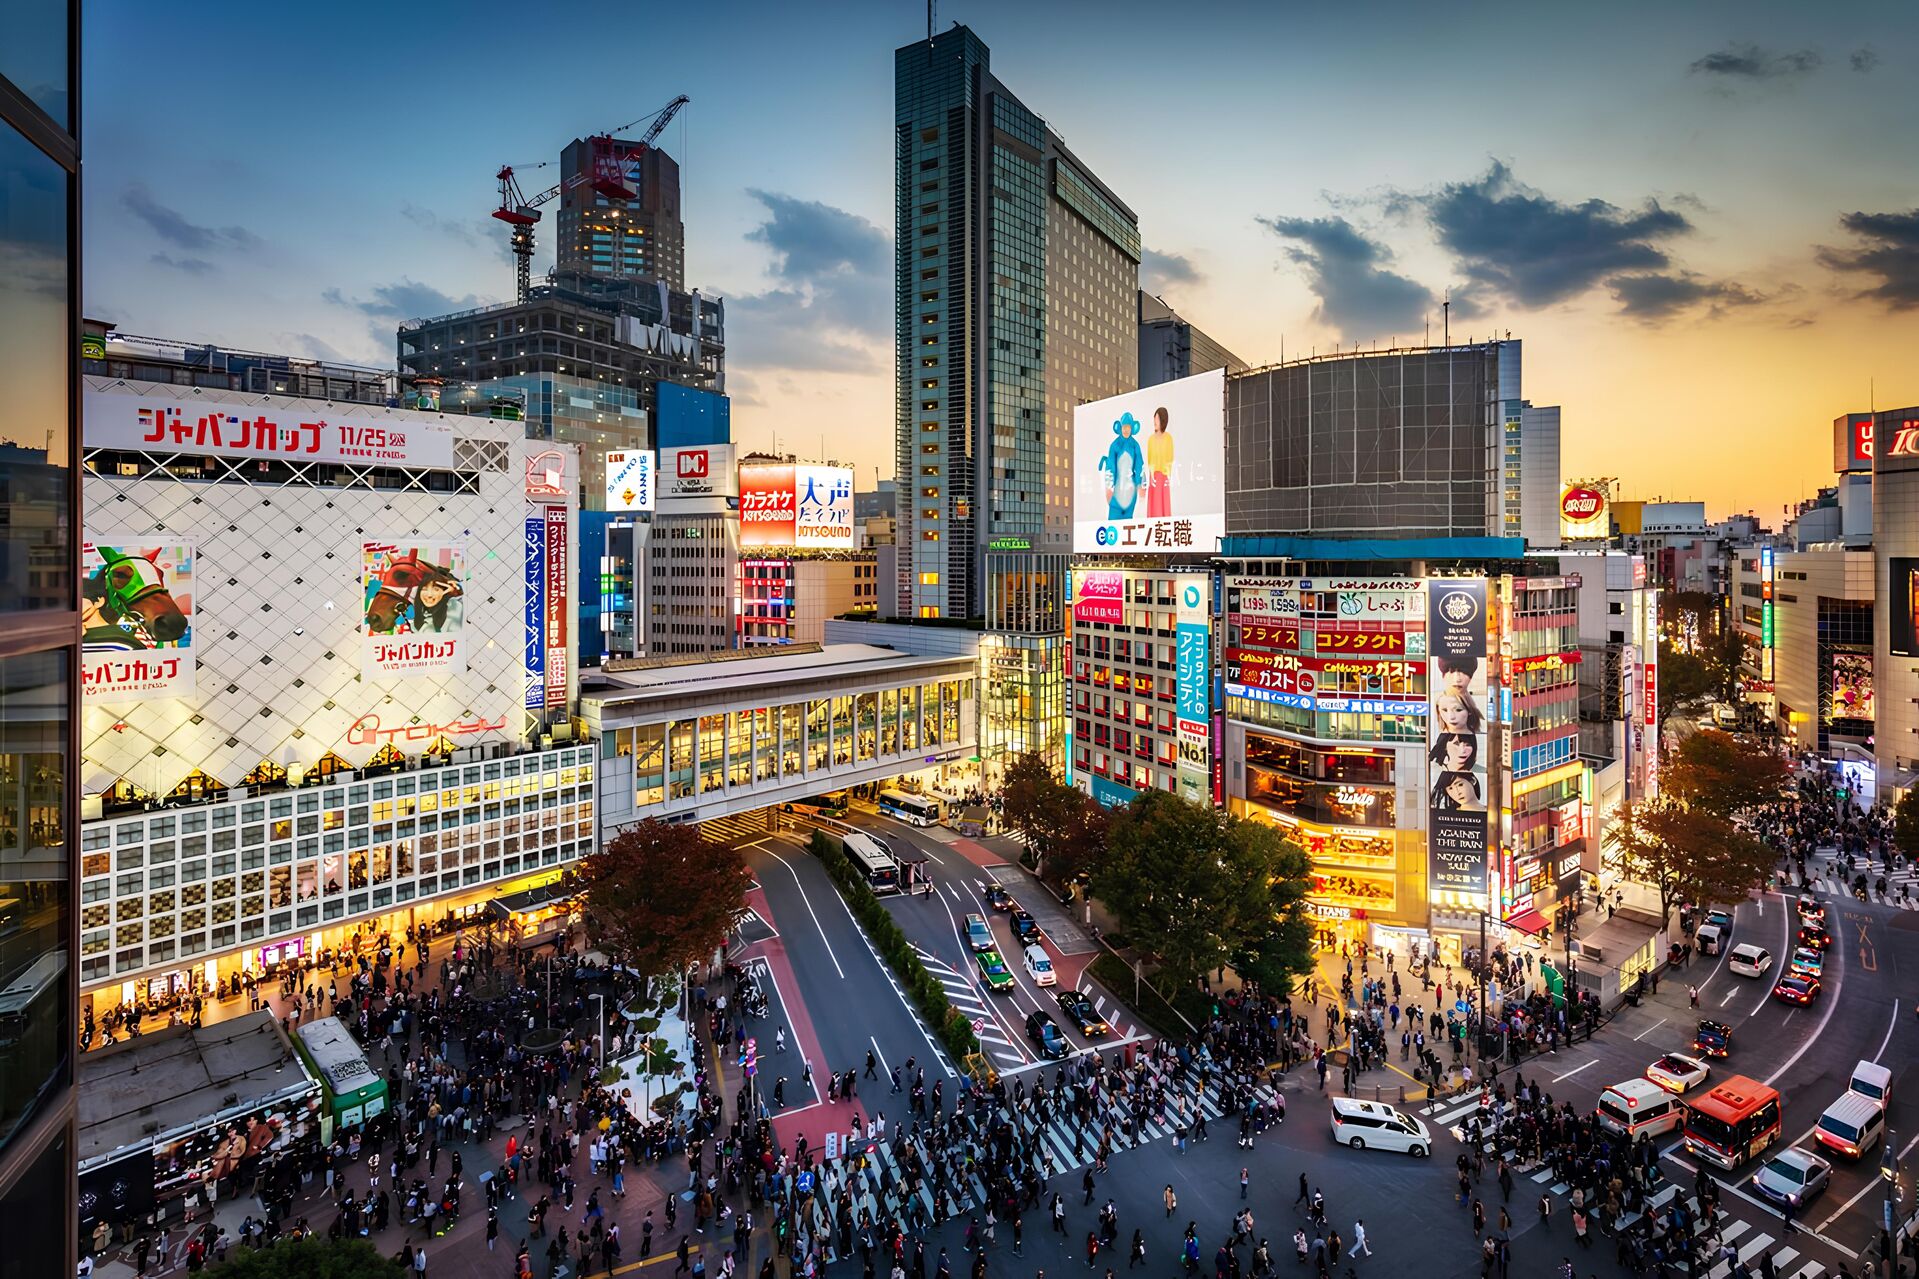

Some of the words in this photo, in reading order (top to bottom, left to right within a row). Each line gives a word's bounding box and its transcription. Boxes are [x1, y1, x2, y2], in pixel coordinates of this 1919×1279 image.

[138, 408, 327, 453] ジャパンカップ
[339, 427, 385, 447] 11/25
[743, 490, 793, 508] カラオケ
[798, 476, 850, 506] 大声
[1121, 519, 1192, 547] エン転職
[1367, 596, 1404, 611] しゃぶ
[1242, 627, 1297, 645] プライス
[1317, 634, 1401, 649] コンタクト
[1273, 654, 1303, 671] ガスト
[1376, 661, 1417, 677] ガスト
[1180, 631, 1193, 713] アイシティ
[1195, 633, 1205, 715] コンタクトの
[1259, 670, 1295, 689] ガスト
[1179, 740, 1207, 765] No.1
[1436, 838, 1456, 847] THE
